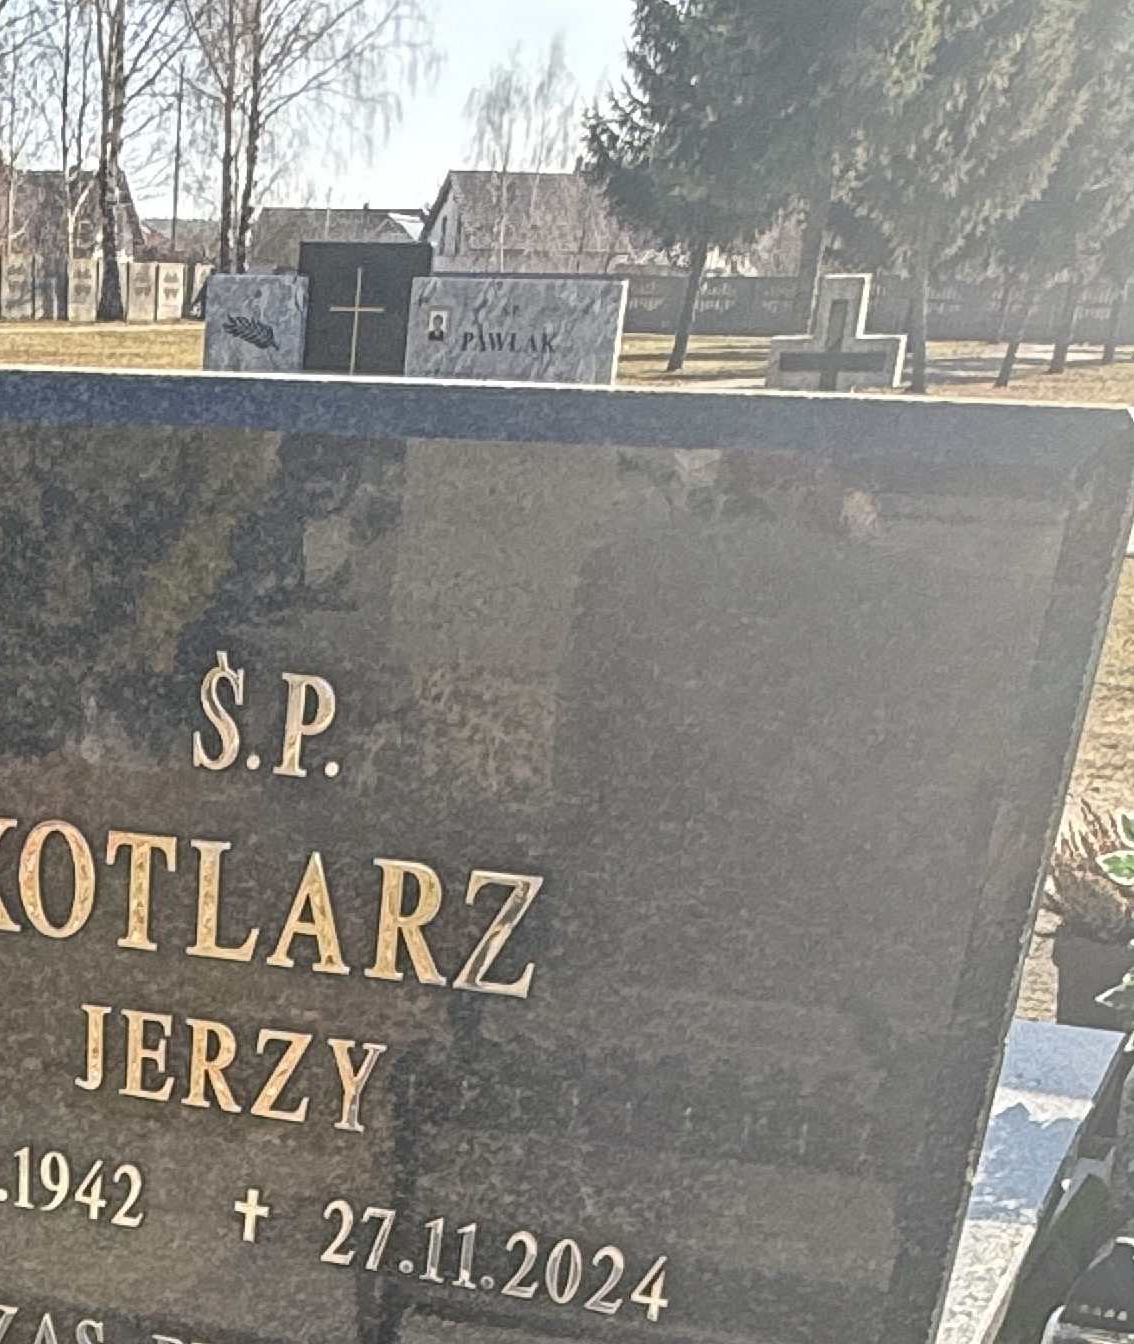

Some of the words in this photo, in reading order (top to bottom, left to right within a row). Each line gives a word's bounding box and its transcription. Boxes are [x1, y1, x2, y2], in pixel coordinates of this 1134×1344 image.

[192, 650, 340, 778] Ś.P.
[75, 1004, 388, 1133] JERZY
[319, 1200, 670, 1322] 27.11.2024
